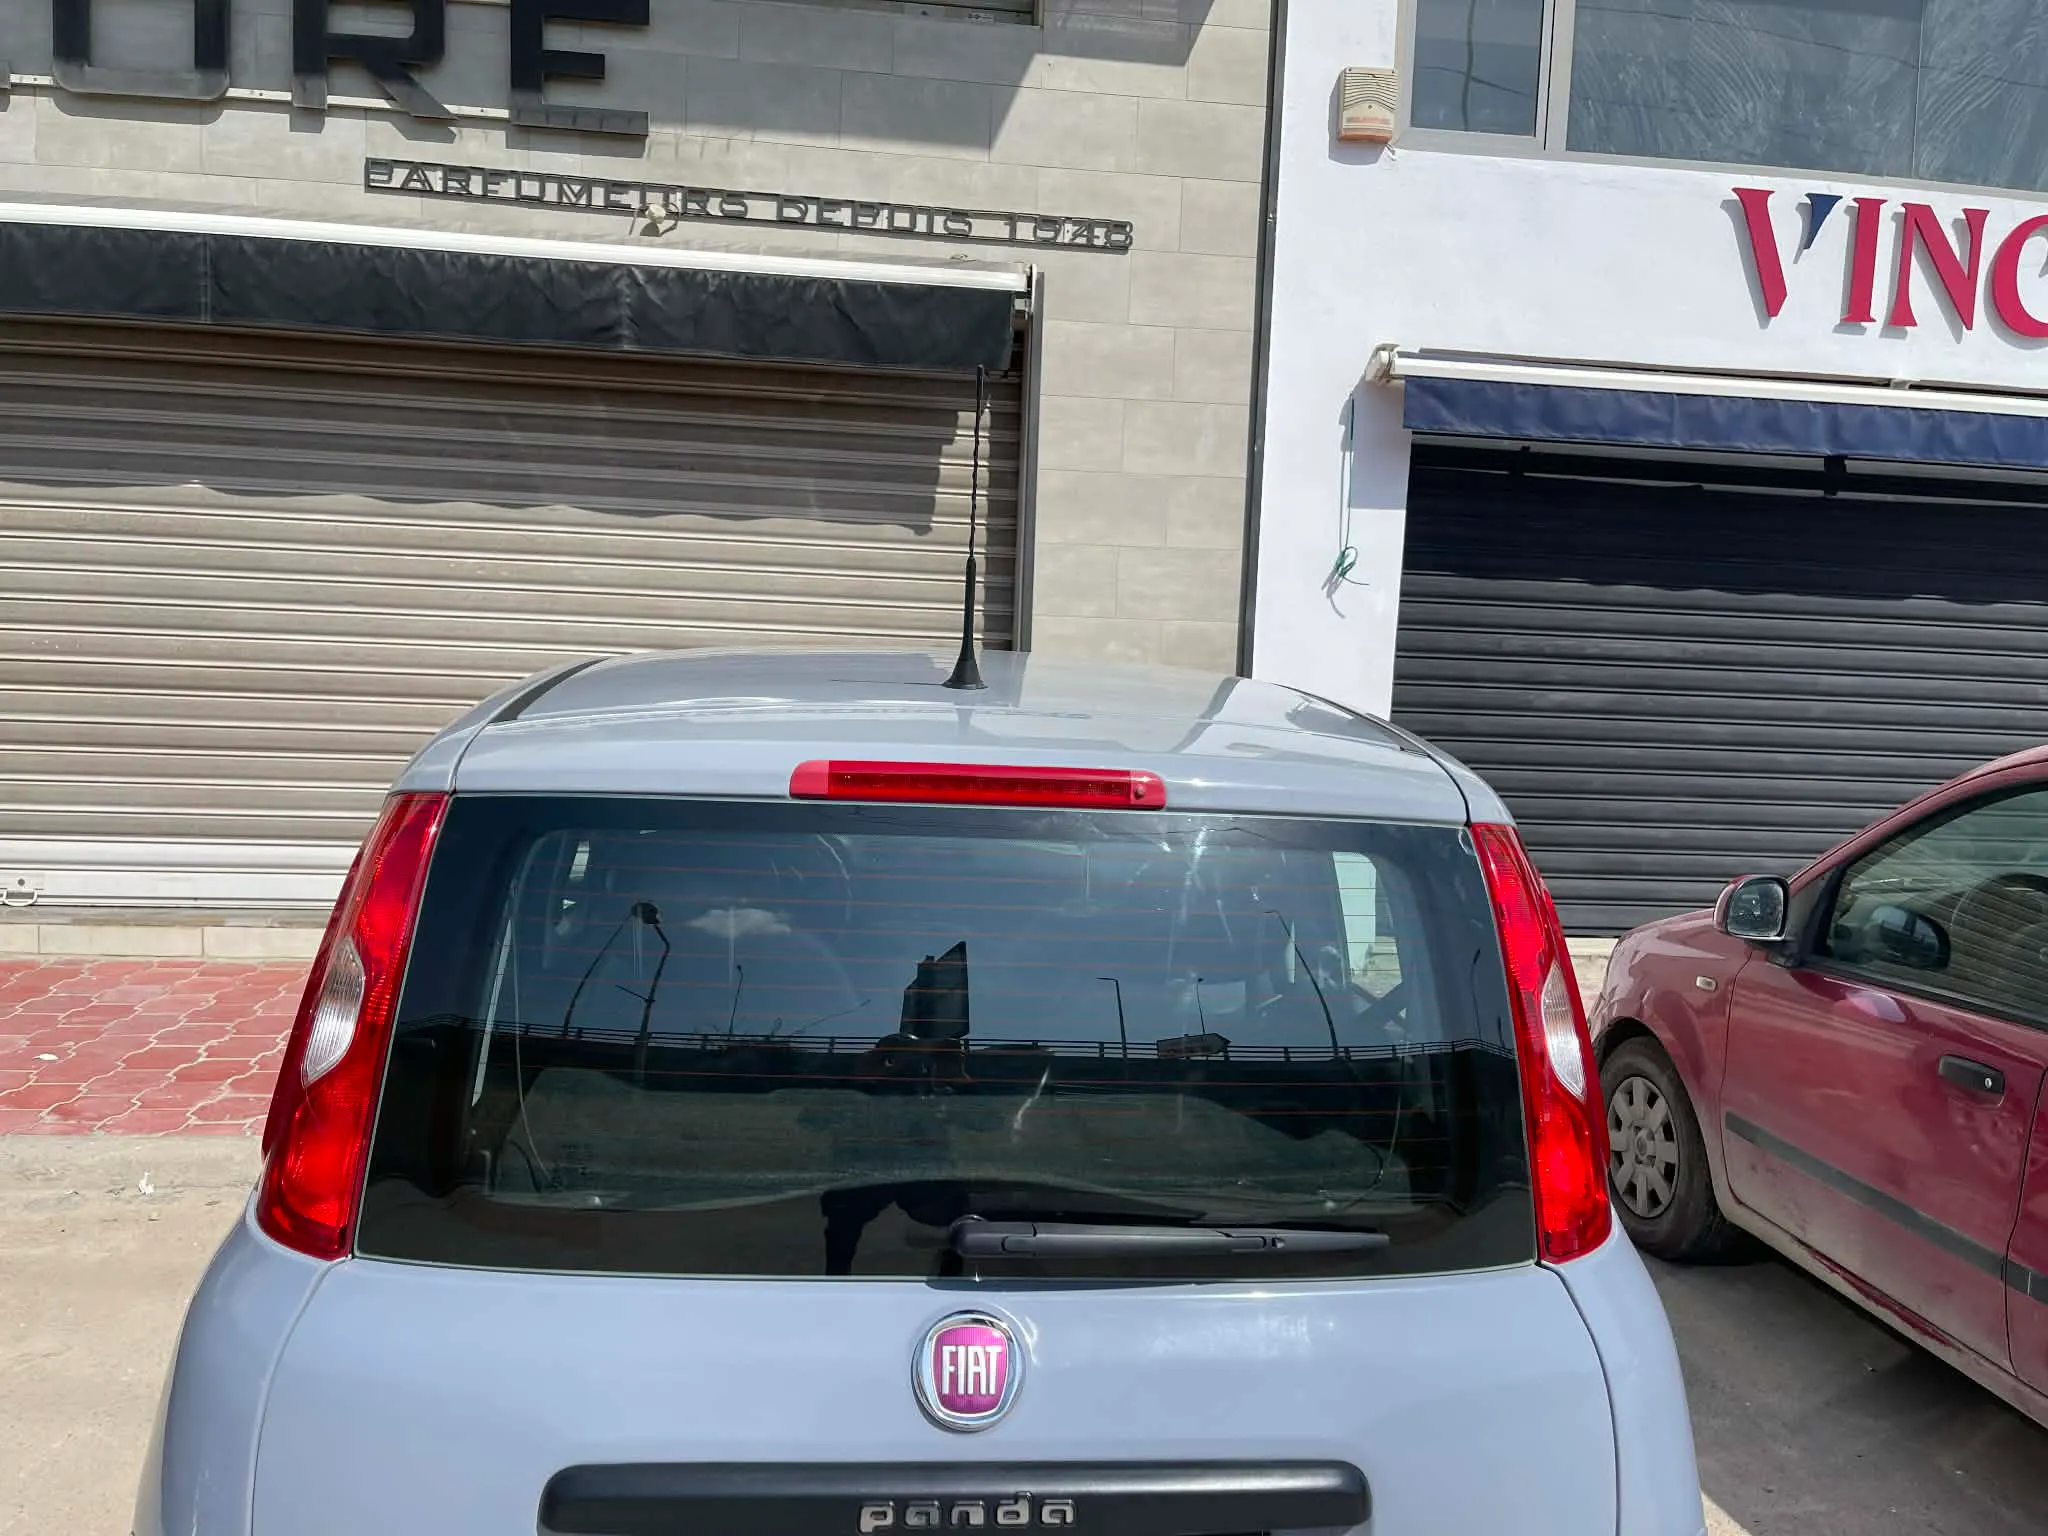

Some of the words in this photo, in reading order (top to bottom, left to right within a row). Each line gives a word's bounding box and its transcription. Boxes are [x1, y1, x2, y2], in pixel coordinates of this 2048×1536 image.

[0, 0, 650, 136] URE
[364, 157, 749, 219] PARFUMEURS
[776, 193, 973, 237] DEPUIS
[1002, 211, 1133, 248] 1948
[940, 1344, 1003, 1396] FIAT
[857, 1491, 1077, 1535] panda
